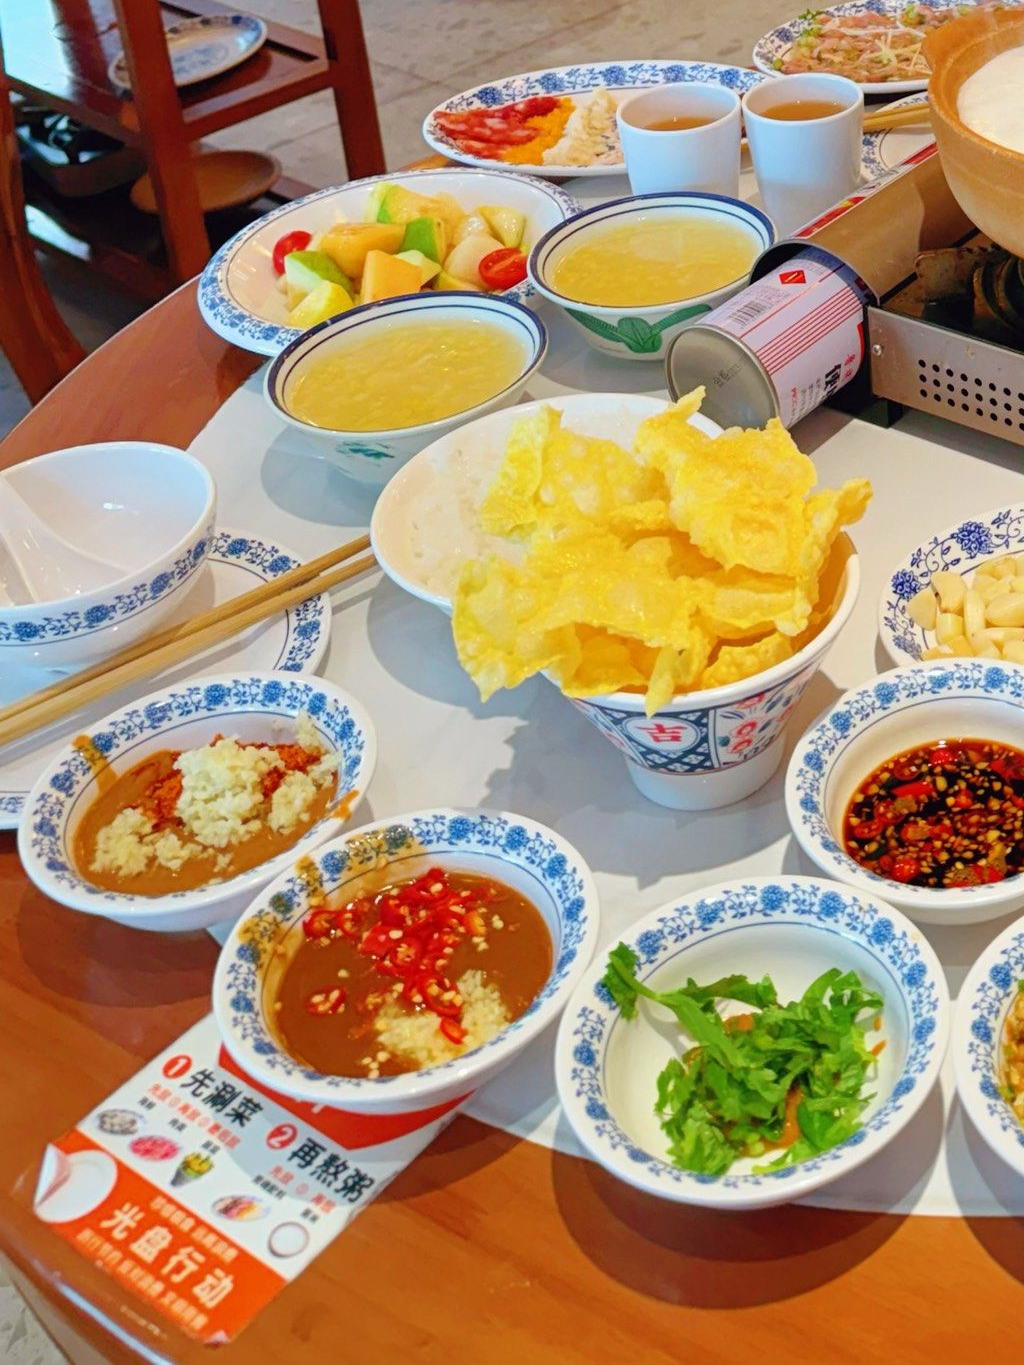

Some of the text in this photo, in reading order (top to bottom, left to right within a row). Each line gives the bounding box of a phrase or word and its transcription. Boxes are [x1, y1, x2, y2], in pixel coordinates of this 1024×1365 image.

[634, 722, 689, 744] 吉
[180, 1068, 263, 1128] 先涮菜
[287, 1137, 375, 1203] 再熬粥
[99, 1202, 235, 1310] 光盘行动
